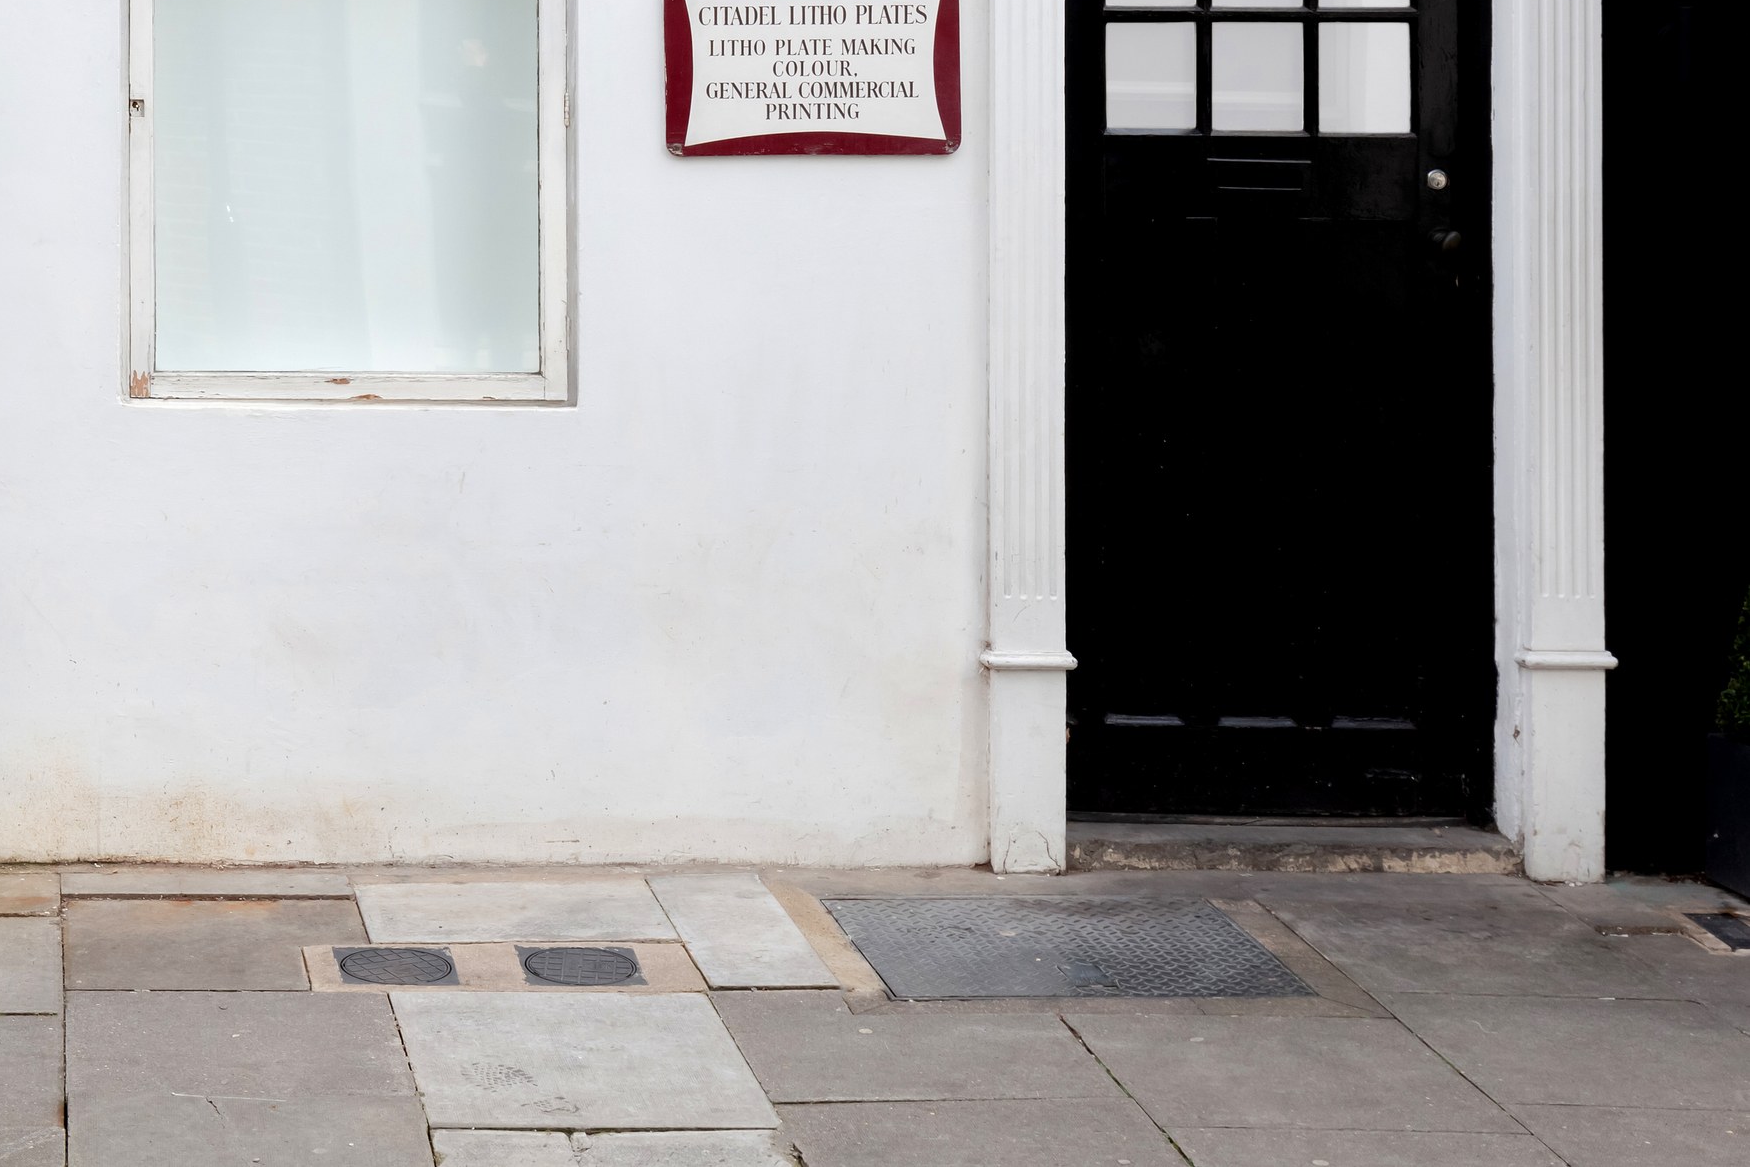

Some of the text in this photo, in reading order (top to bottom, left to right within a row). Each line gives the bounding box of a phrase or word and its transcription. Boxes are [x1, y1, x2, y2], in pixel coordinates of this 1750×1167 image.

[698, 4, 928, 26] CITADEL LITHO PLATES
[709, 38, 916, 57] LITHO PLATE MAKING
[772, 60, 858, 78] COLOUR,
[706, 81, 919, 100] GENERAL COMMERCIAL
[765, 103, 860, 120] PRINTING
